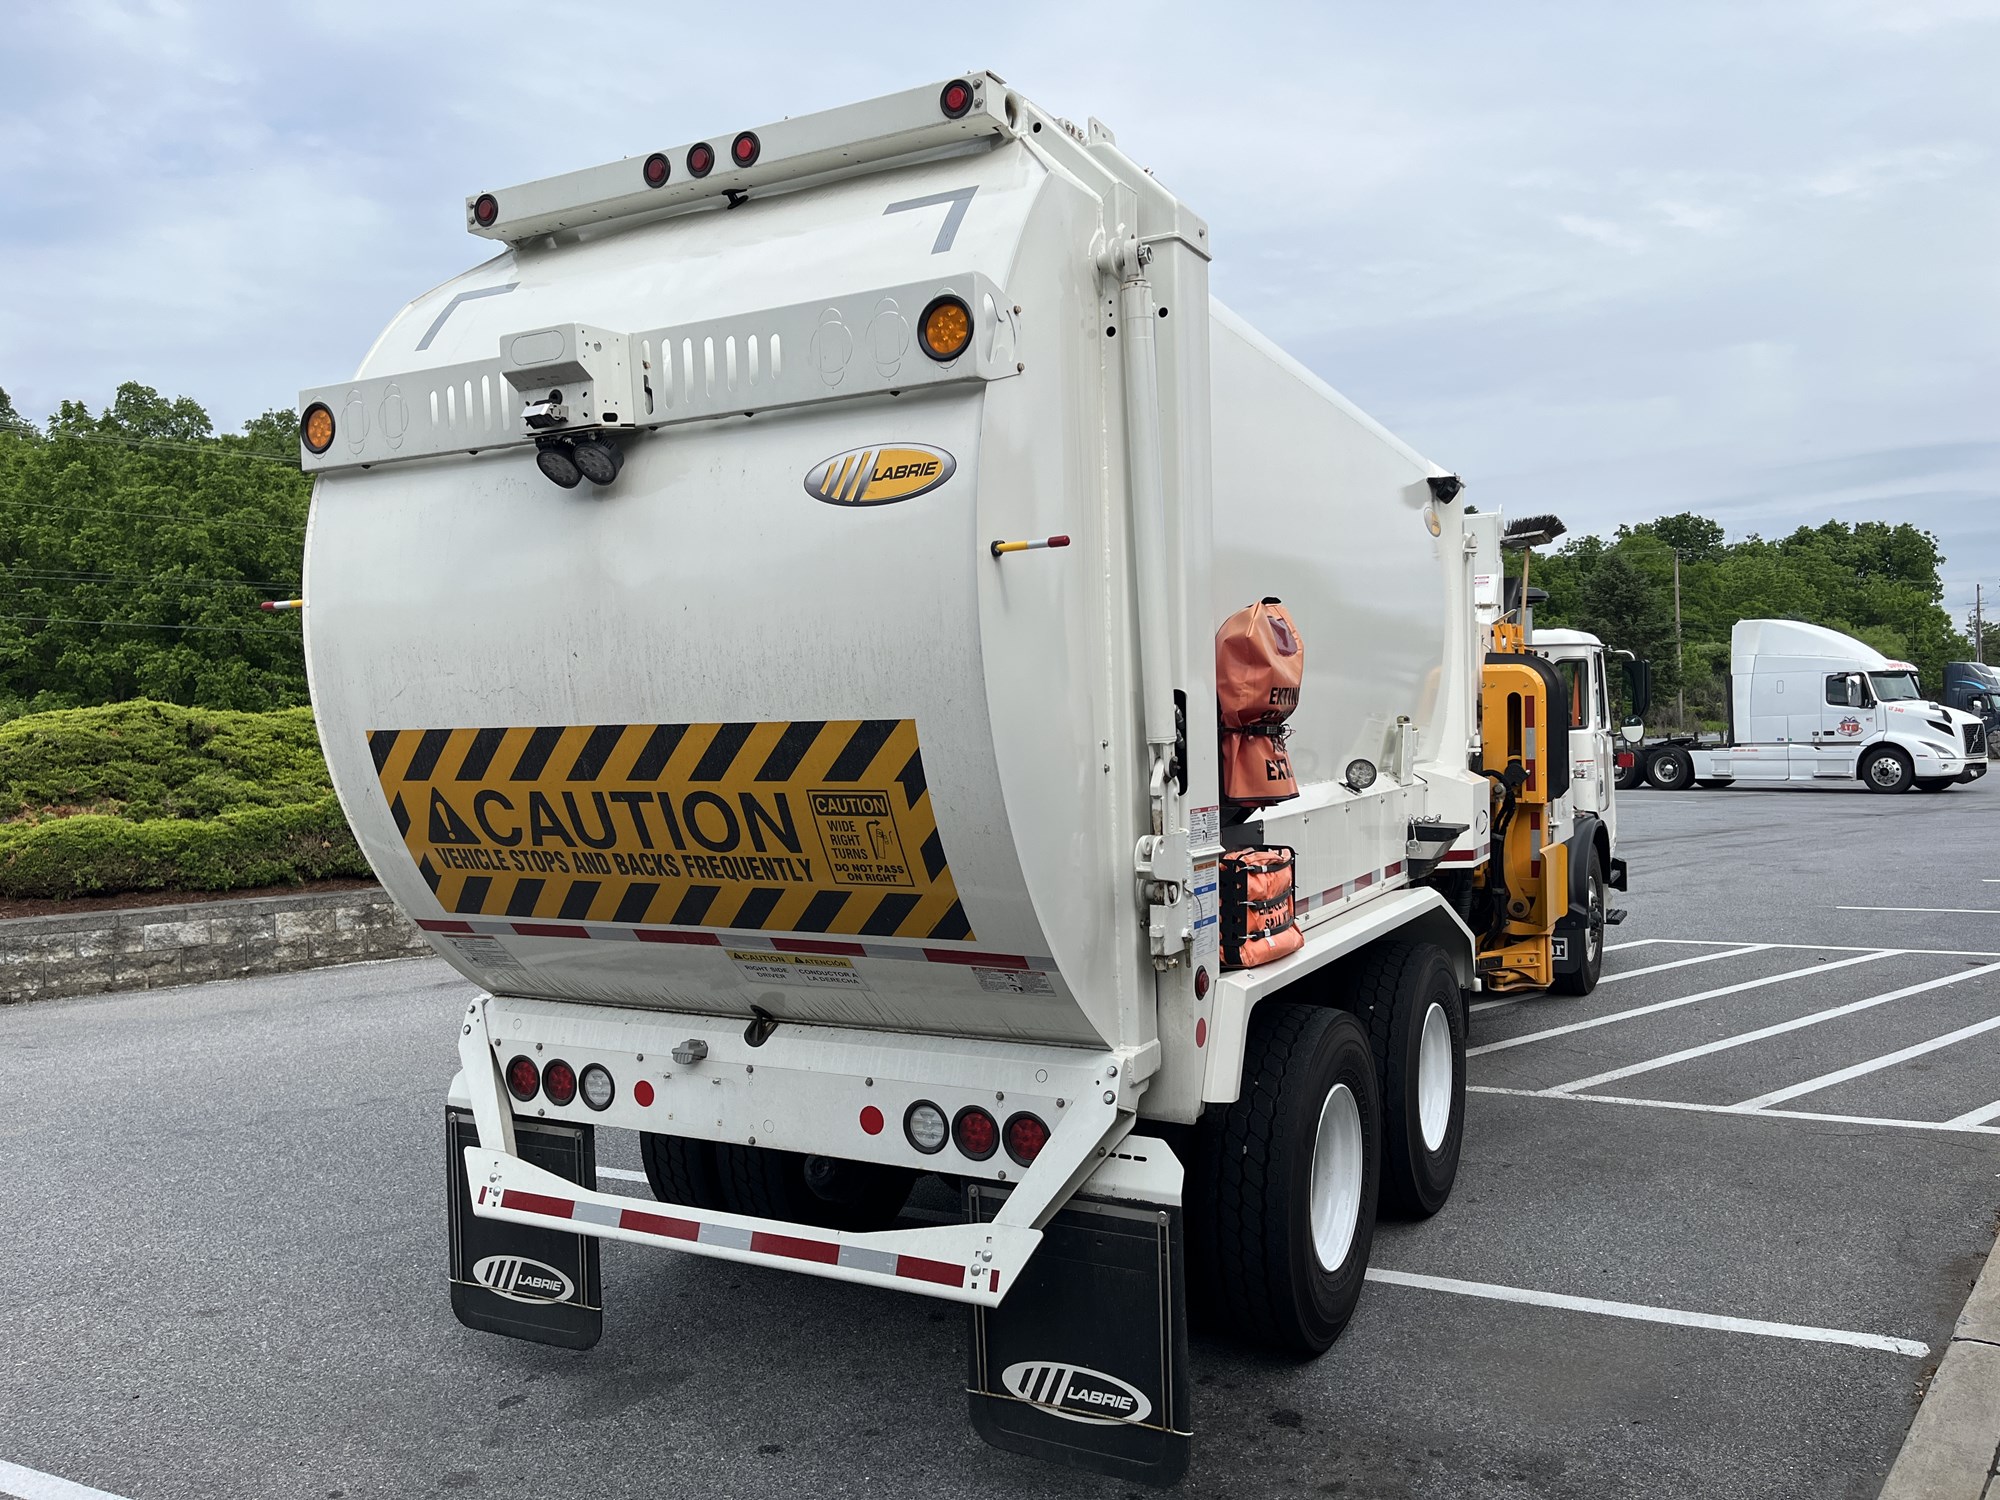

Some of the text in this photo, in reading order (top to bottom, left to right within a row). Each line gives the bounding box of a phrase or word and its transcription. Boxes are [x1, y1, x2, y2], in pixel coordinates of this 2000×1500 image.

[871, 461, 939, 482] LABRIE
[815, 797, 886, 814] CAUTION
[473, 789, 803, 853] CAUTION
[827, 820, 856, 832] WIDE
[830, 834, 861, 846] RIGHT
[831, 848, 868, 860] TURNS
[434, 848, 814, 883] VEHICLE STOPS AND BACKS FREQUENTLY
[834, 863, 904, 874] DO NOT PASS
[847, 873, 897, 883] ON RIGHT
[742, 953, 785, 963] CAUTION
[770, 966, 789, 974] SIDE
[798, 968, 851, 978] CONDUCTOR
[820, 976, 860, 984] DERECHA
[517, 1274, 562, 1292] LABRIE
[1067, 1386, 1134, 1411] LABRIE
